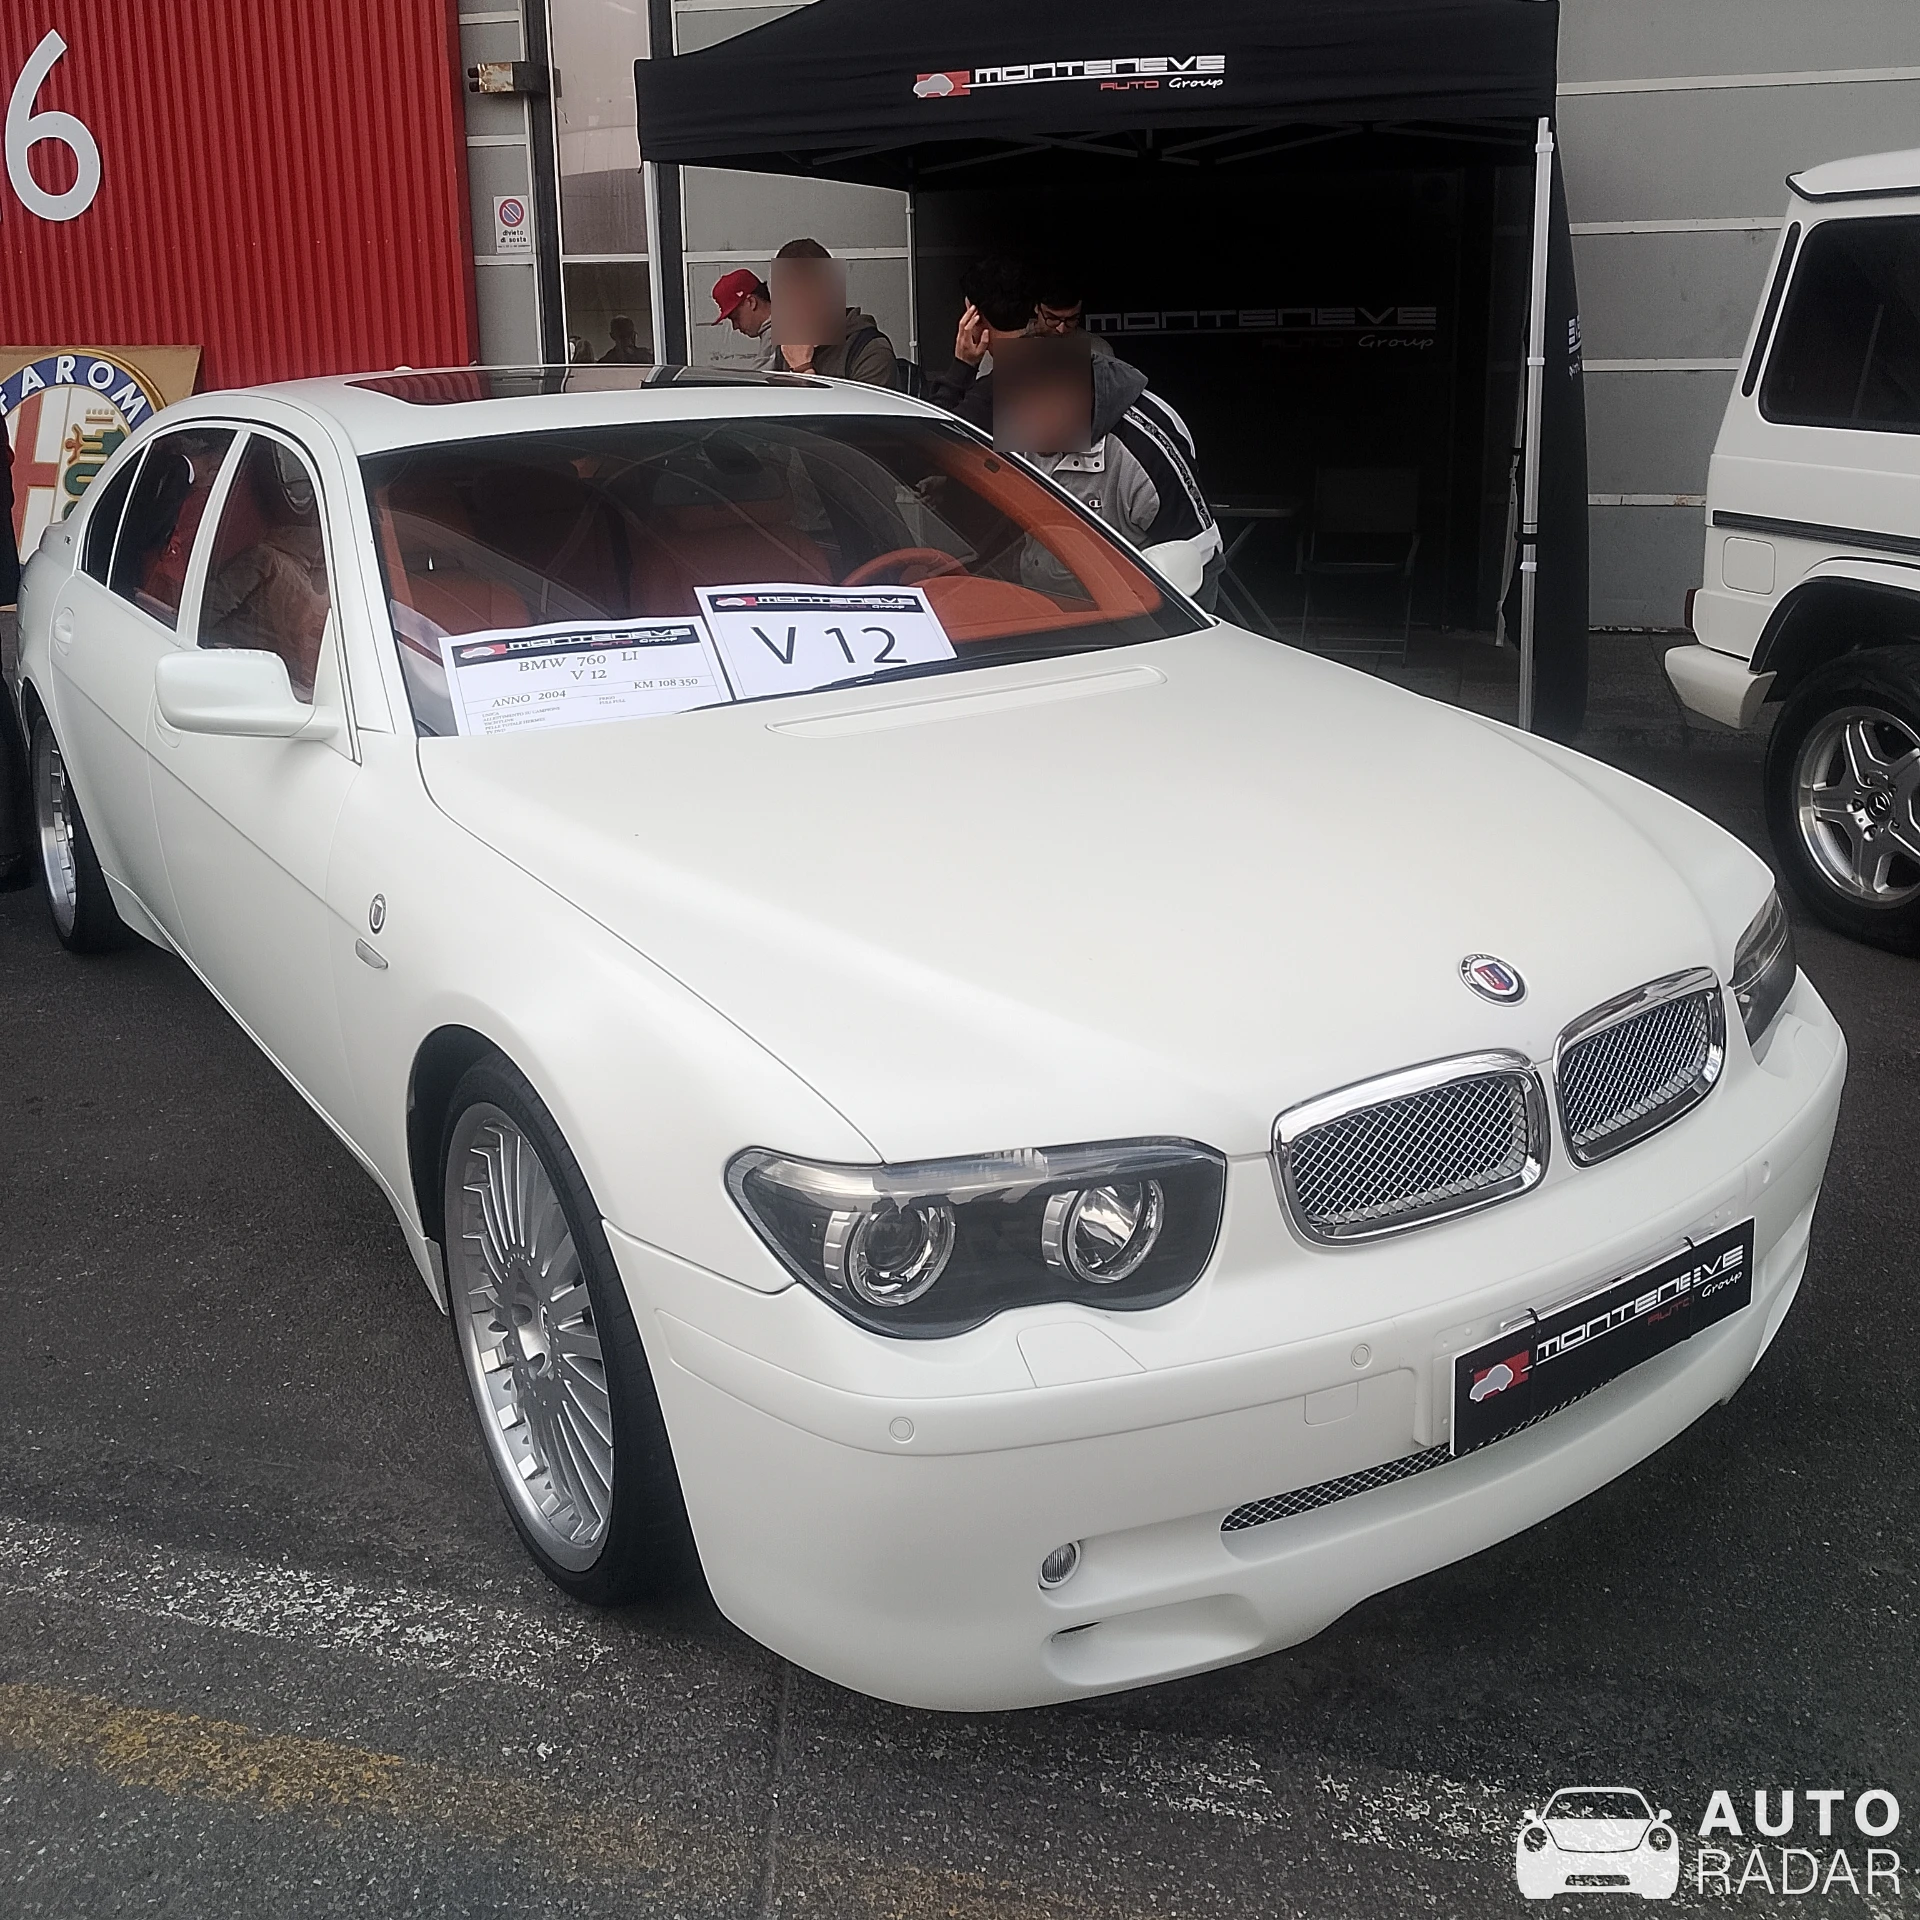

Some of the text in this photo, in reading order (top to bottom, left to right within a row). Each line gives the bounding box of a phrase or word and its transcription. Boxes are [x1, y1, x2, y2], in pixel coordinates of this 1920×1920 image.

[975, 55, 1226, 83] MONTENEVE
[1100, 77, 1224, 91] AUTO Group
[5, 28, 102, 221] 6
[1358, 334, 1435, 350] Group
[750, 626, 908, 664] V 12
[518, 650, 639, 673] BMW 760 LI
[570, 669, 608, 681] V 12
[633, 680, 655, 690] KM
[491, 689, 567, 708] ANNO 2004
[1701, 1270, 1743, 1298] Group
